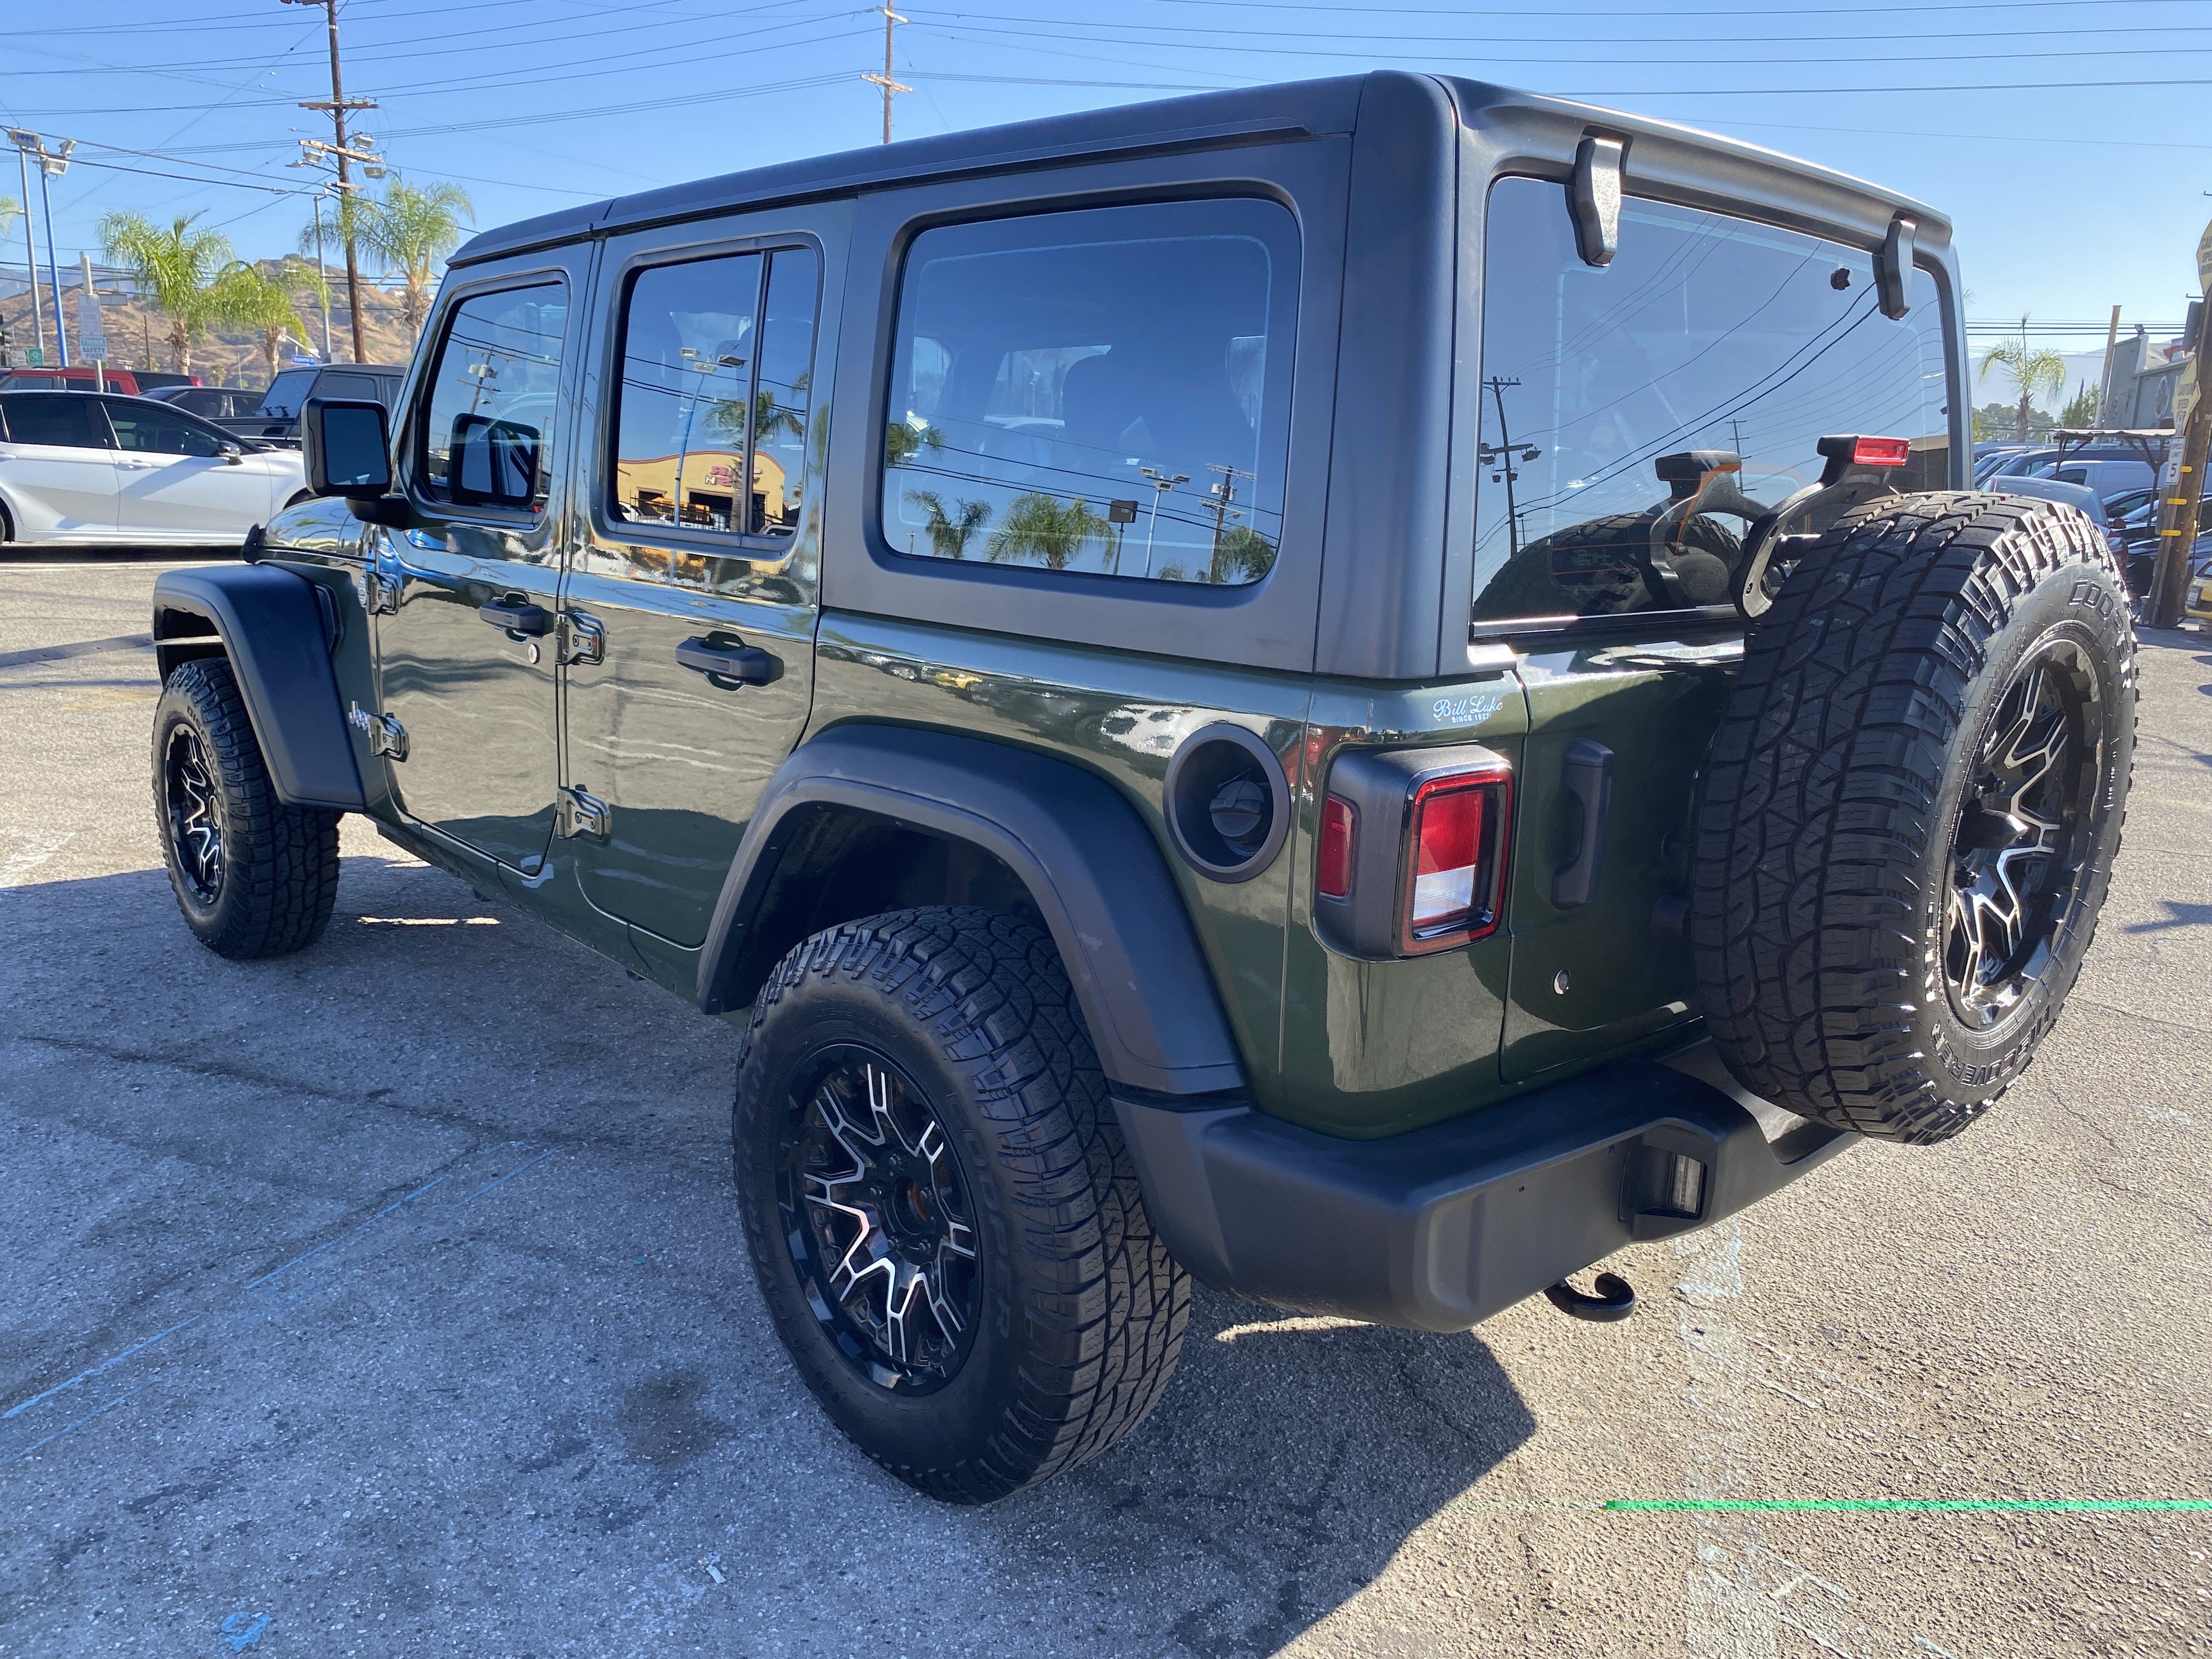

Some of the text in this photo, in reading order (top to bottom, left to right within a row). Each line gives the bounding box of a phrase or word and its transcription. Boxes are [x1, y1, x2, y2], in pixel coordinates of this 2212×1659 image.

[2170, 463, 2177, 477] 5
[1433, 695, 1503, 722] Bill Luke
[1451, 715, 1472, 723] SINCE
[945, 1093, 1013, 1339] COOPER
